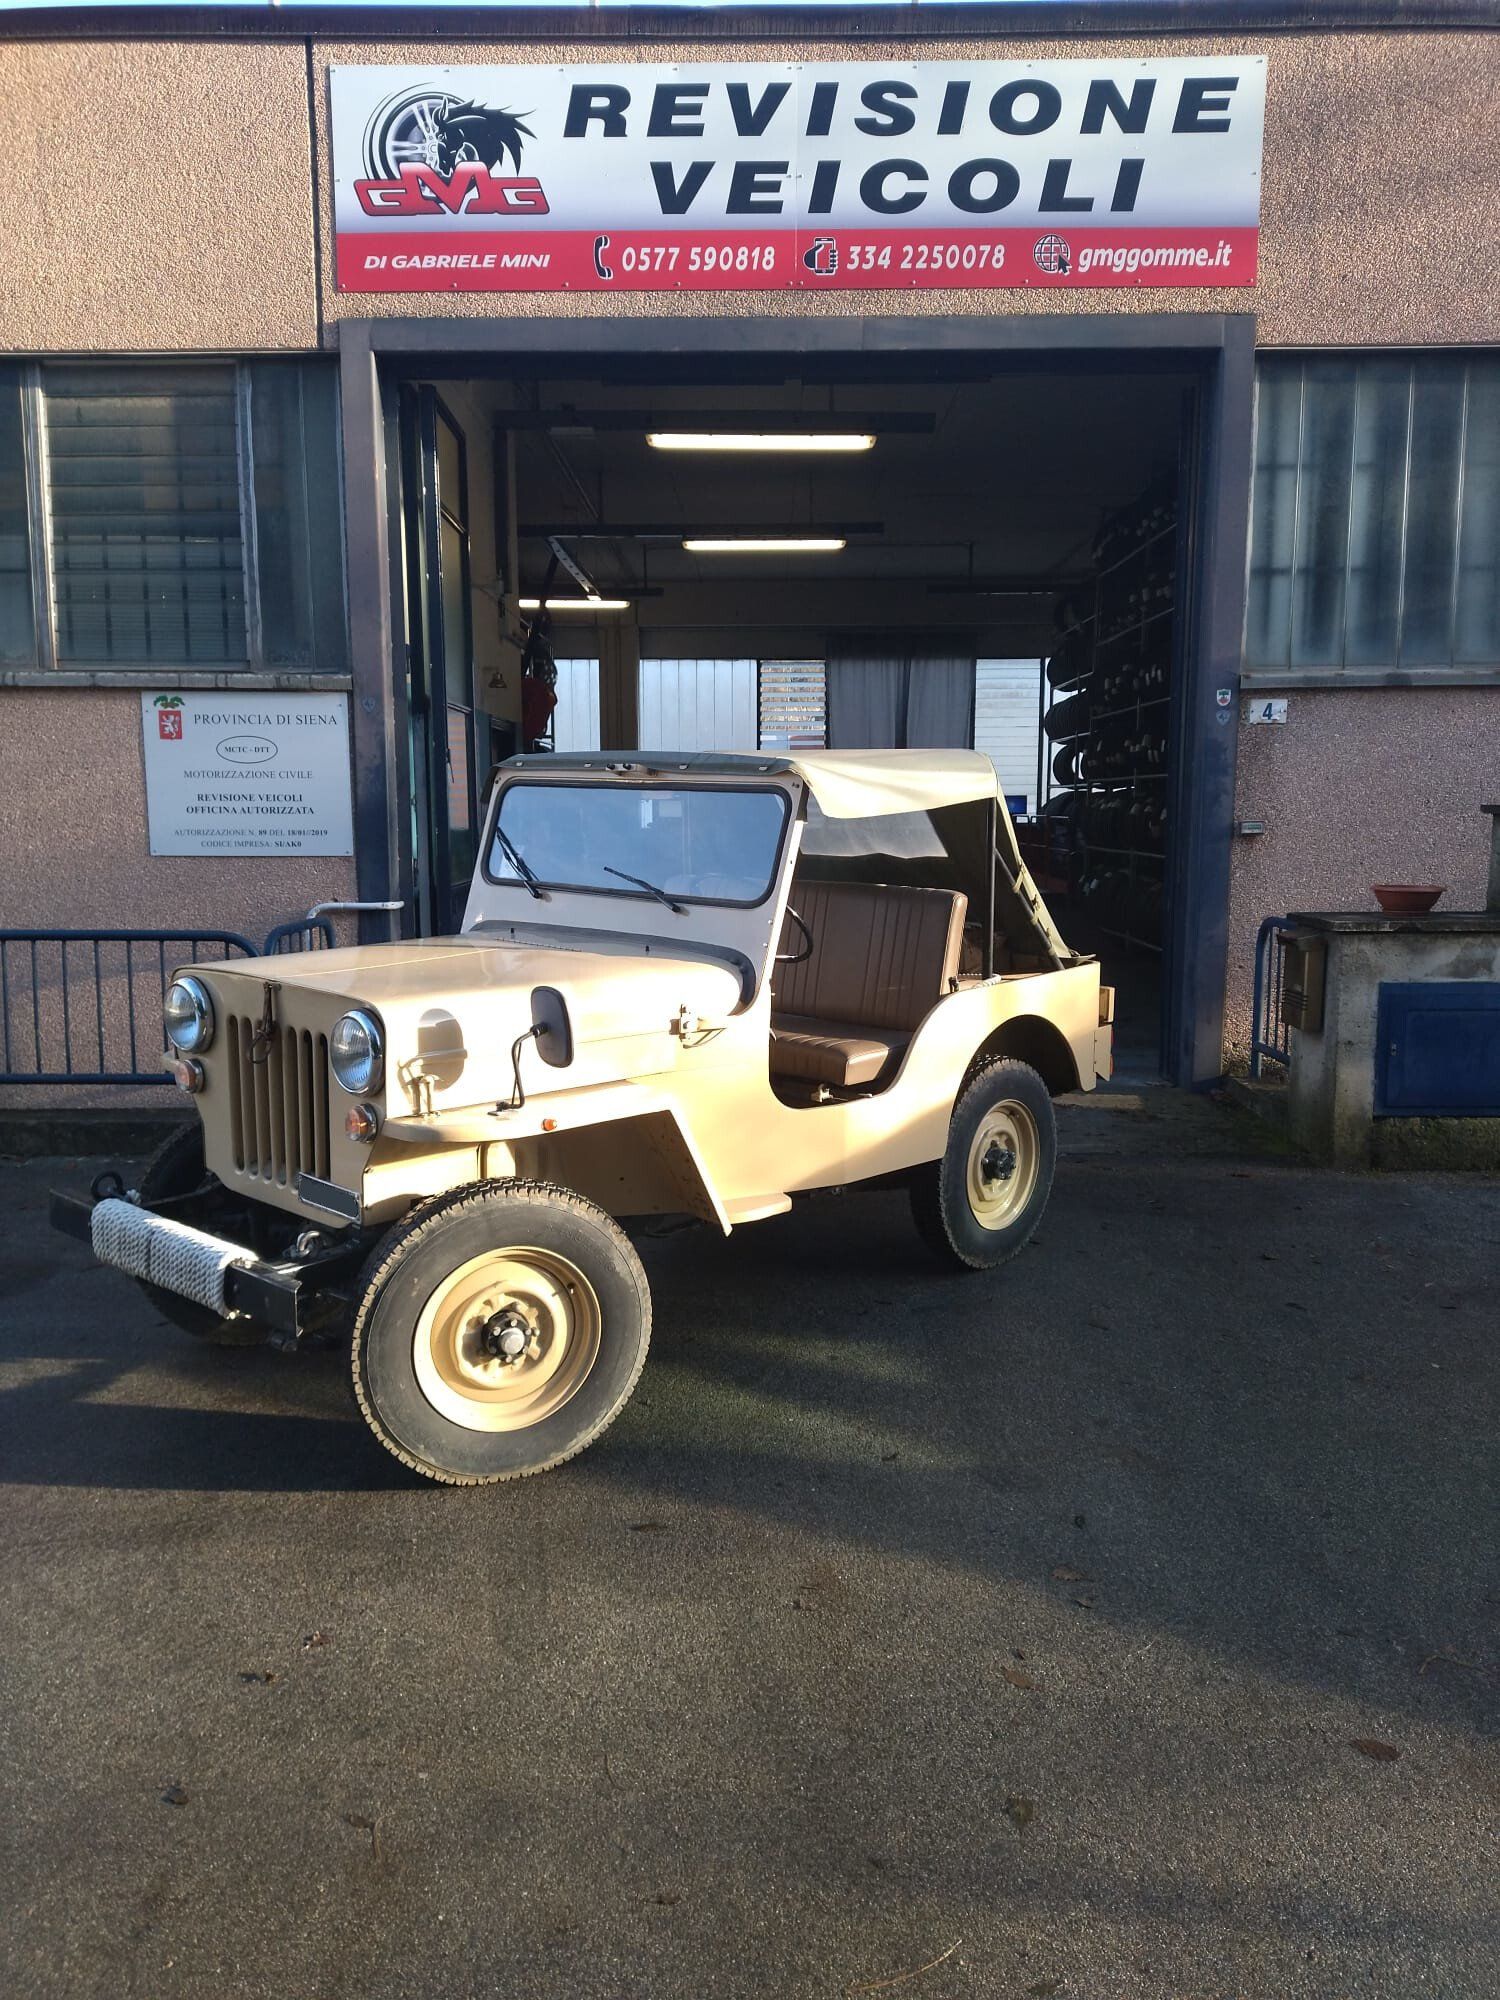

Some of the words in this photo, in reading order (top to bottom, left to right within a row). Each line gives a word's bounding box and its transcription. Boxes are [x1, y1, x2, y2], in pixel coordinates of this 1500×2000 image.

[563, 76, 1239, 138] REVISIONE
[353, 161, 550, 217] GMG
[650, 158, 1145, 215] VEICOLI
[364, 255, 382, 269] DI
[391, 254, 496, 269] GABRIELE
[497, 254, 550, 268] MINI
[622, 247, 677, 271] 0577
[688, 246, 776, 271] 590818
[846, 245, 890, 270] 334
[900, 244, 1006, 270] 2250078
[1078, 240, 1233, 273] gmggomme.it
[193, 714, 272, 726] PROVINCIA
[276, 714, 292, 726] DI
[295, 714, 338, 726] SIENA
[1262, 702, 1273, 720] 4
[183, 770, 276, 779] MOTORIZZAZIONE
[278, 770, 313, 779] CIVILE
[197, 793, 255, 802] REVISIONE
[258, 793, 303, 802] VEICOLI
[186, 806, 238, 815] OFFICINA
[239, 806, 315, 815] AUTORIZZATA
[200, 840, 232, 848] CODICE
